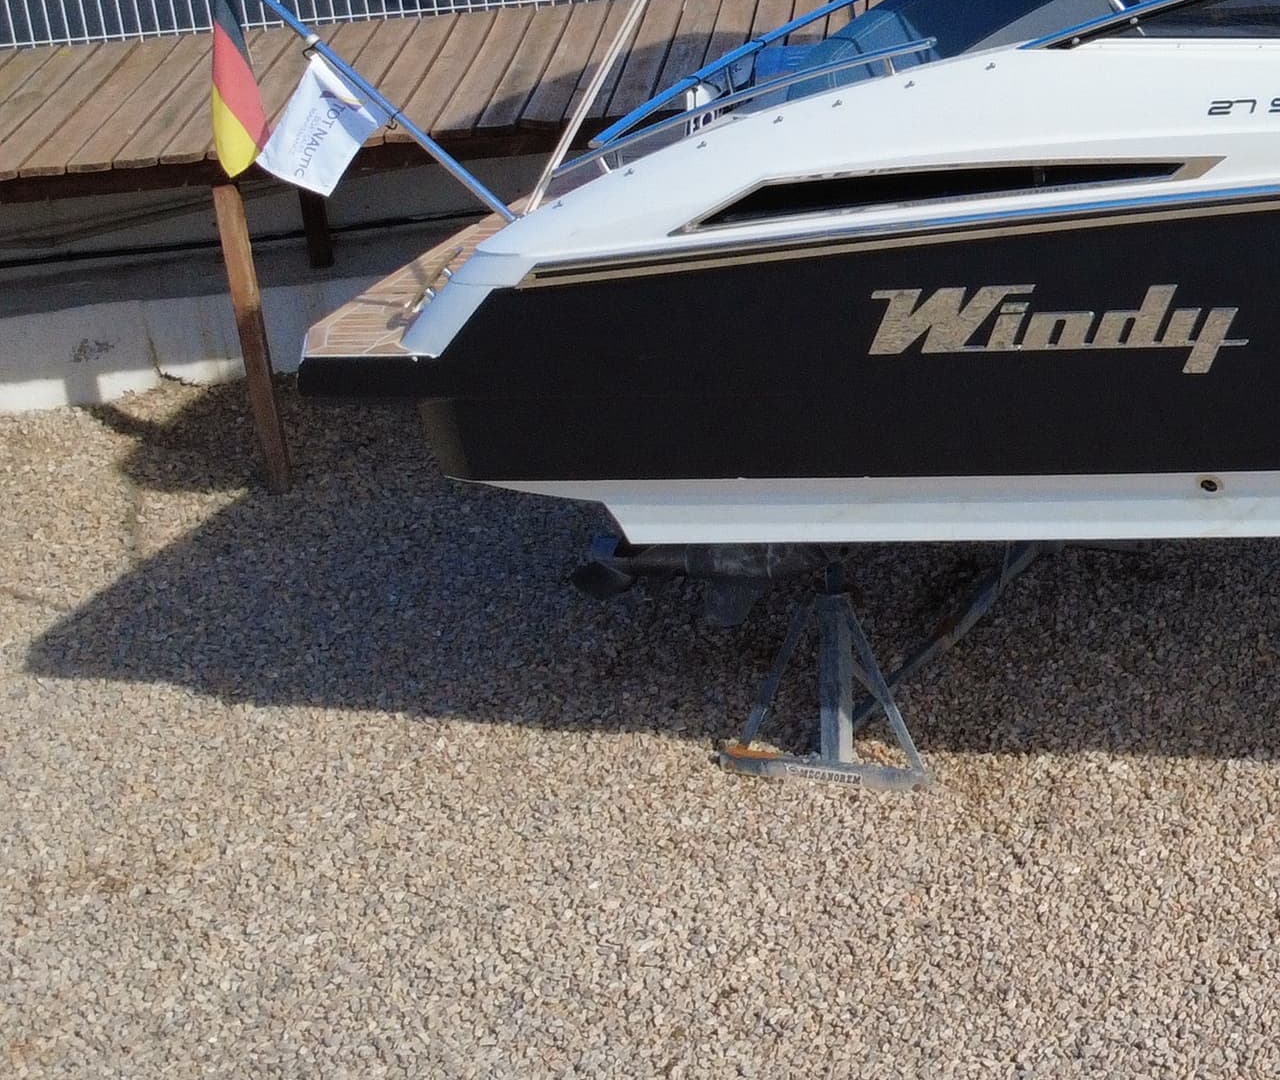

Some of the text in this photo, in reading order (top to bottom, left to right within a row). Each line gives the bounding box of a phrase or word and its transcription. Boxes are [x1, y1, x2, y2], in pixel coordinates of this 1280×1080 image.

[326, 103, 346, 129] TOT
[1207, 98, 1257, 116] 27
[294, 127, 329, 178] NAUTIC
[867, 283, 1250, 375] Windy
